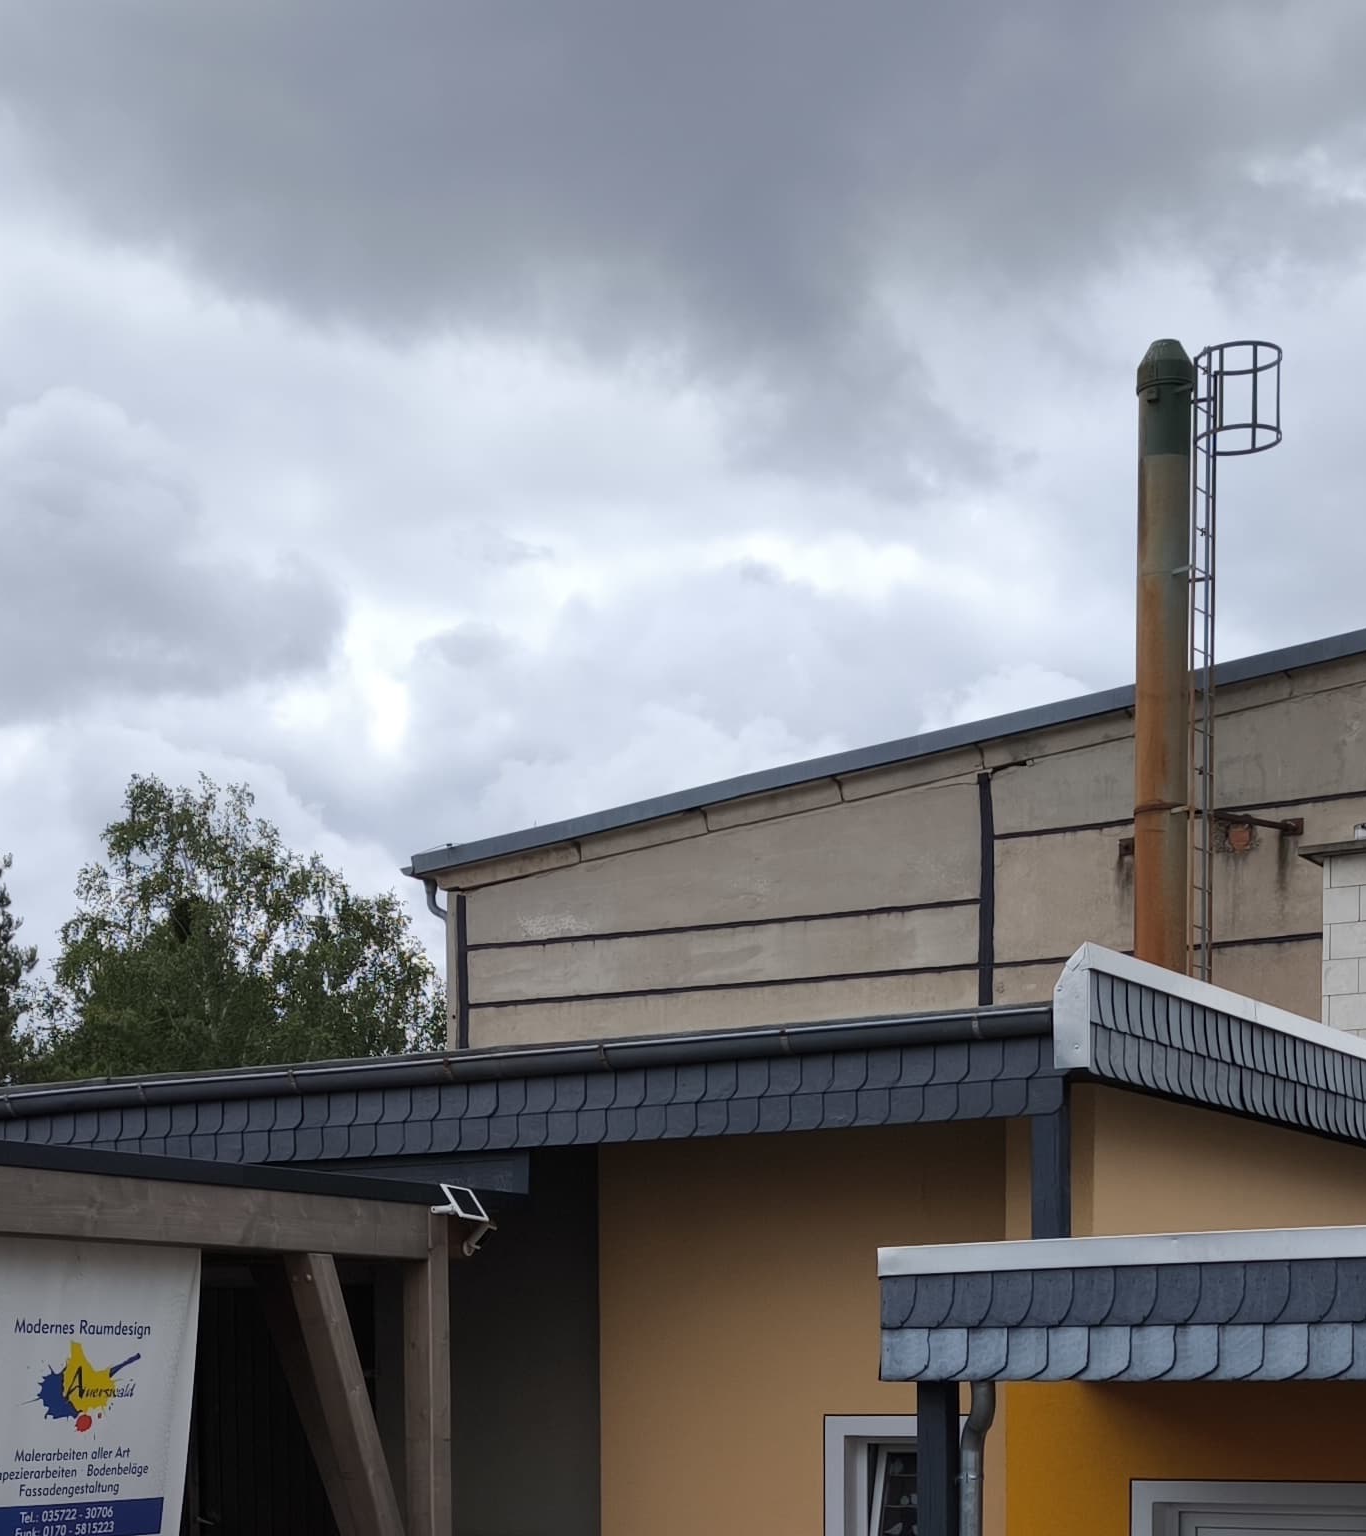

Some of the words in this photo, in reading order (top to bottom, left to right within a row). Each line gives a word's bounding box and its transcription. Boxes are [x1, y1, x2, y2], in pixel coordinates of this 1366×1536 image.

[14, 1318, 75, 1334] Modernes
[80, 1319, 151, 1339] Raumdesign
[65, 1366, 136, 1400] Auerswald
[14, 1448, 88, 1463] Malerarbeiten
[91, 1447, 113, 1460] aller
[115, 1446, 131, 1459] Art
[87, 1462, 149, 1478] Bodenbeläge
[19, 1481, 120, 1498] Fassadengestaltung
[20, 1511, 39, 1524] Tel.:
[42, 1508, 77, 1523] 035722
[85, 1506, 114, 1520] 30706
[75, 1521, 115, 1536] 5815223
